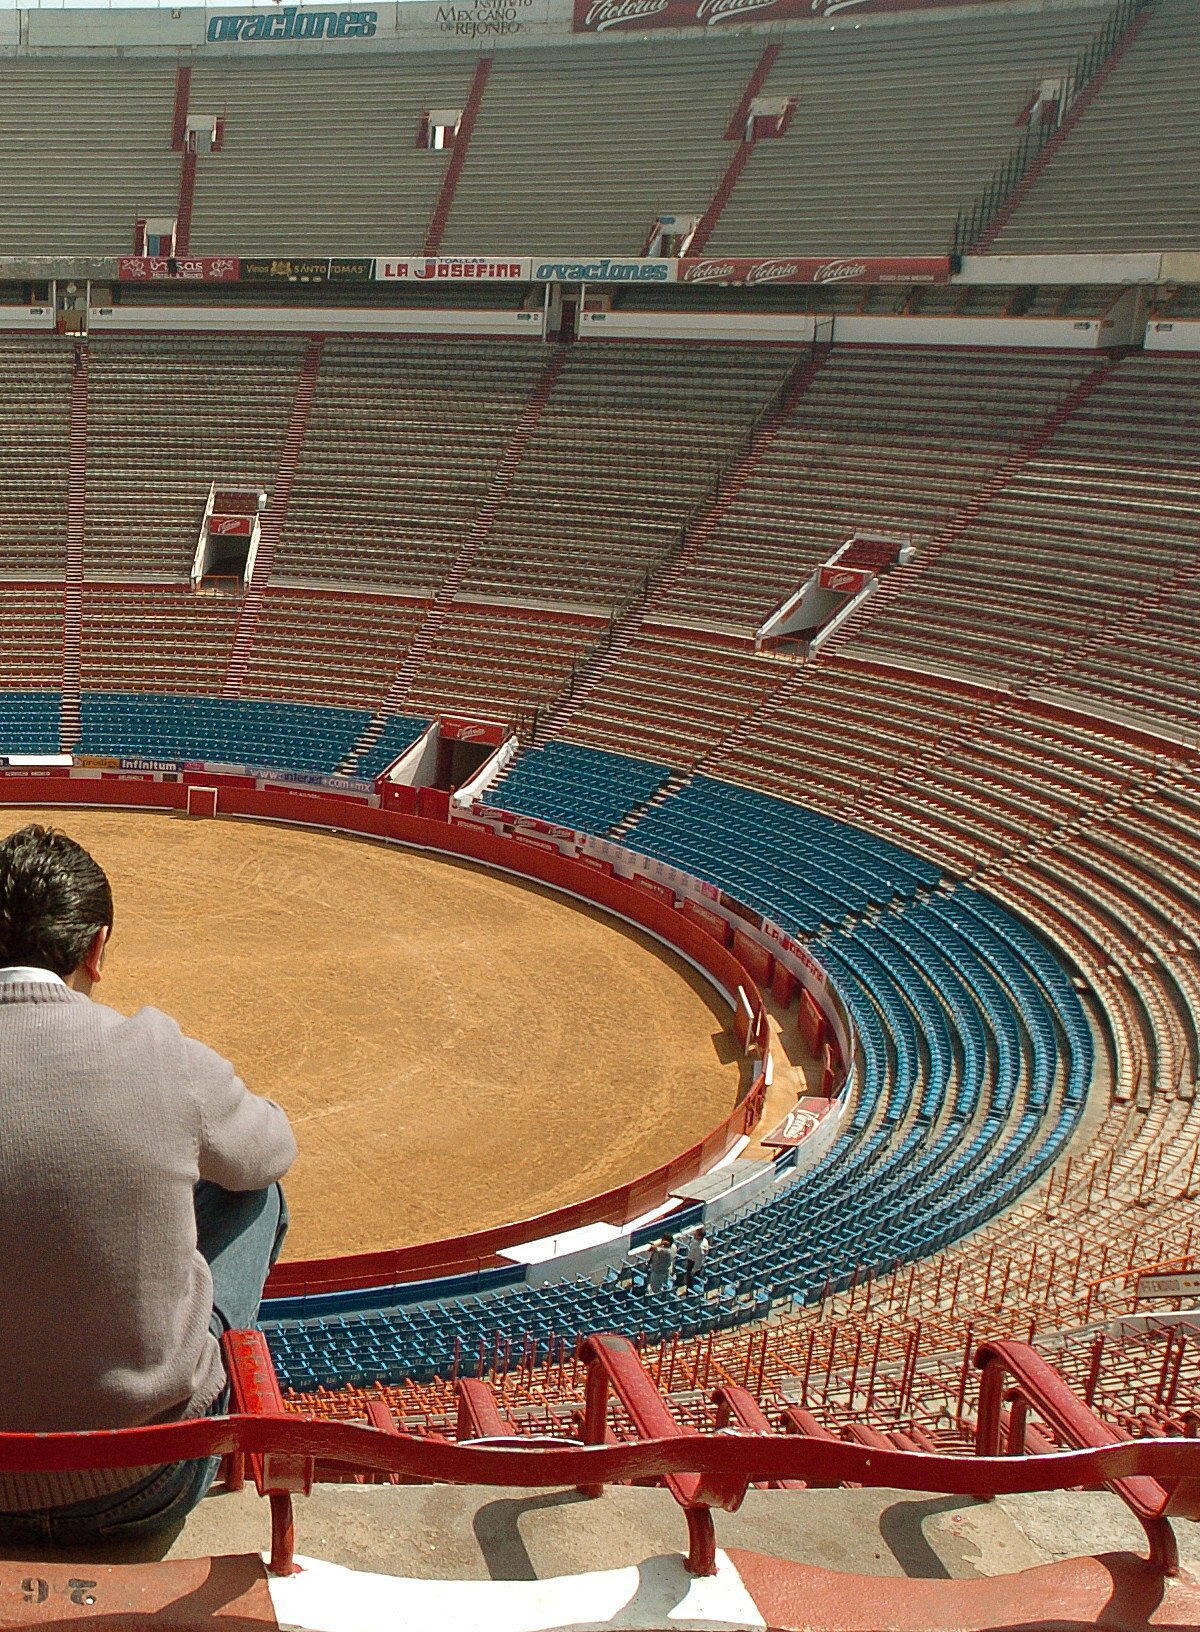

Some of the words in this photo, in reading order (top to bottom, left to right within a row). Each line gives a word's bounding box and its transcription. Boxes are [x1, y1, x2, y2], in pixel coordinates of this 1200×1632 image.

[207, 7, 378, 42] ovaciones
[435, 6, 517, 21] MEXCANO
[150, 258, 203, 271] brsas
[385, 263, 409, 278] LA
[536, 259, 669, 281] ovaciones
[684, 259, 736, 284] Victoria
[746, 259, 801, 284] Victoria
[813, 259, 868, 285] Victoria
